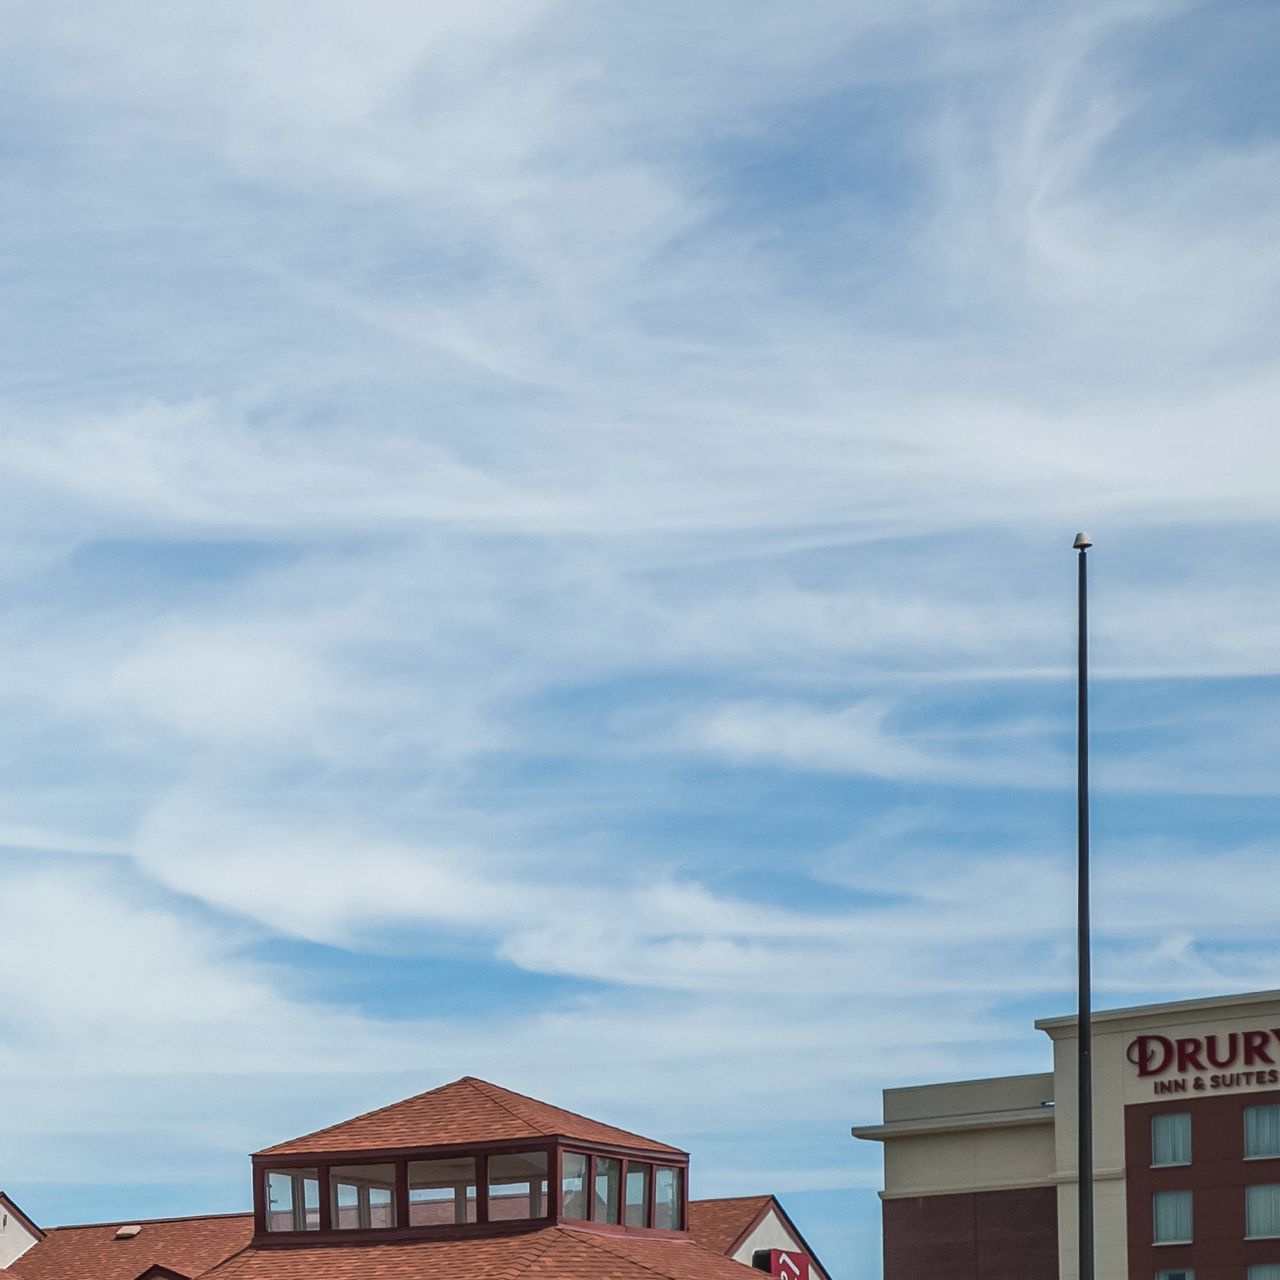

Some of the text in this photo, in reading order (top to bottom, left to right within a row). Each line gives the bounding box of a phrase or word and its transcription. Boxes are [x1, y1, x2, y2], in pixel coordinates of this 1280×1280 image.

[1153, 1069, 1279, 1095] INN & SUITES
